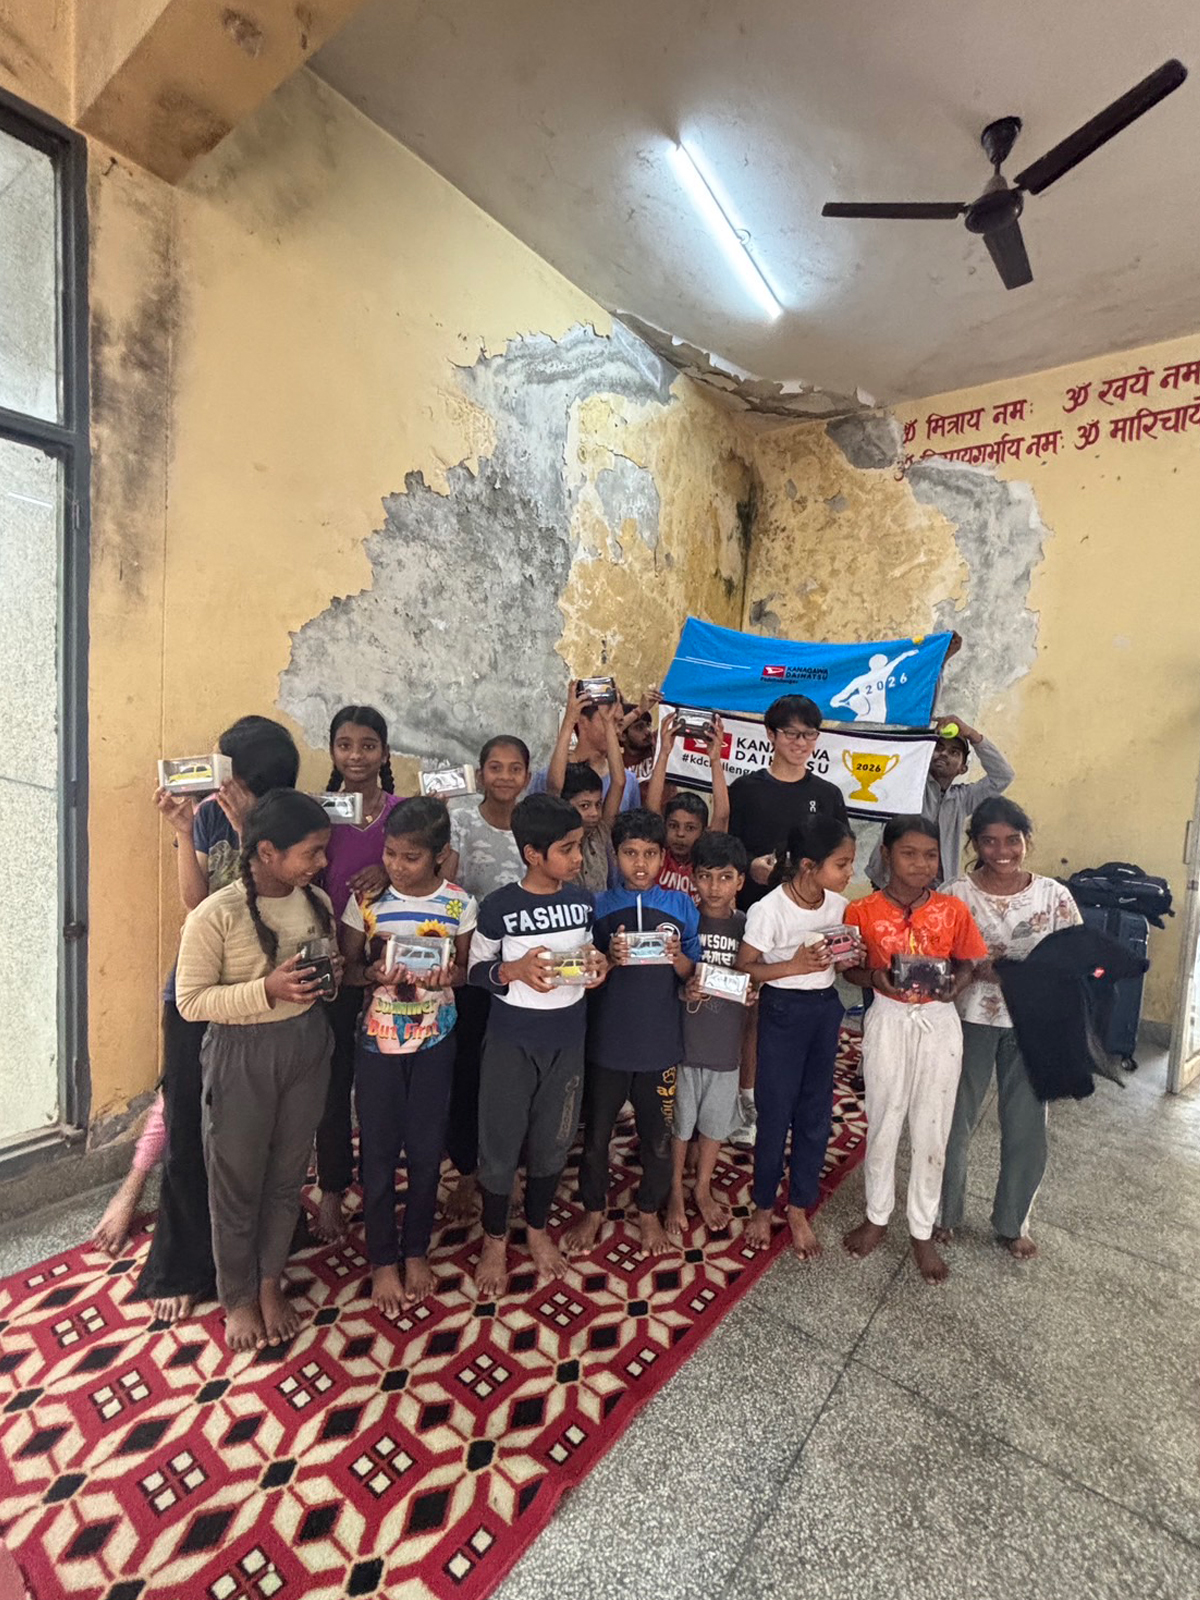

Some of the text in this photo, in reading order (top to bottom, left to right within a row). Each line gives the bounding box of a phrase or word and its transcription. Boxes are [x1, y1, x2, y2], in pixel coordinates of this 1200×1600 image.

[926, 412, 985, 441] मित्राय
[1062, 382, 1092, 413] ॐ
[1098, 366, 1155, 406] रवये
[1074, 419, 1100, 451] ॐ
[786, 672, 828, 681] DAIHATSU
[787, 666, 829, 675] KANAGAWA
[865, 672, 908, 696] 2026
[736, 737, 830, 762] KANWA
[735, 750, 830, 774] DAISU
[856, 762, 882, 773] 2026
[367, 1018, 398, 1040] But
